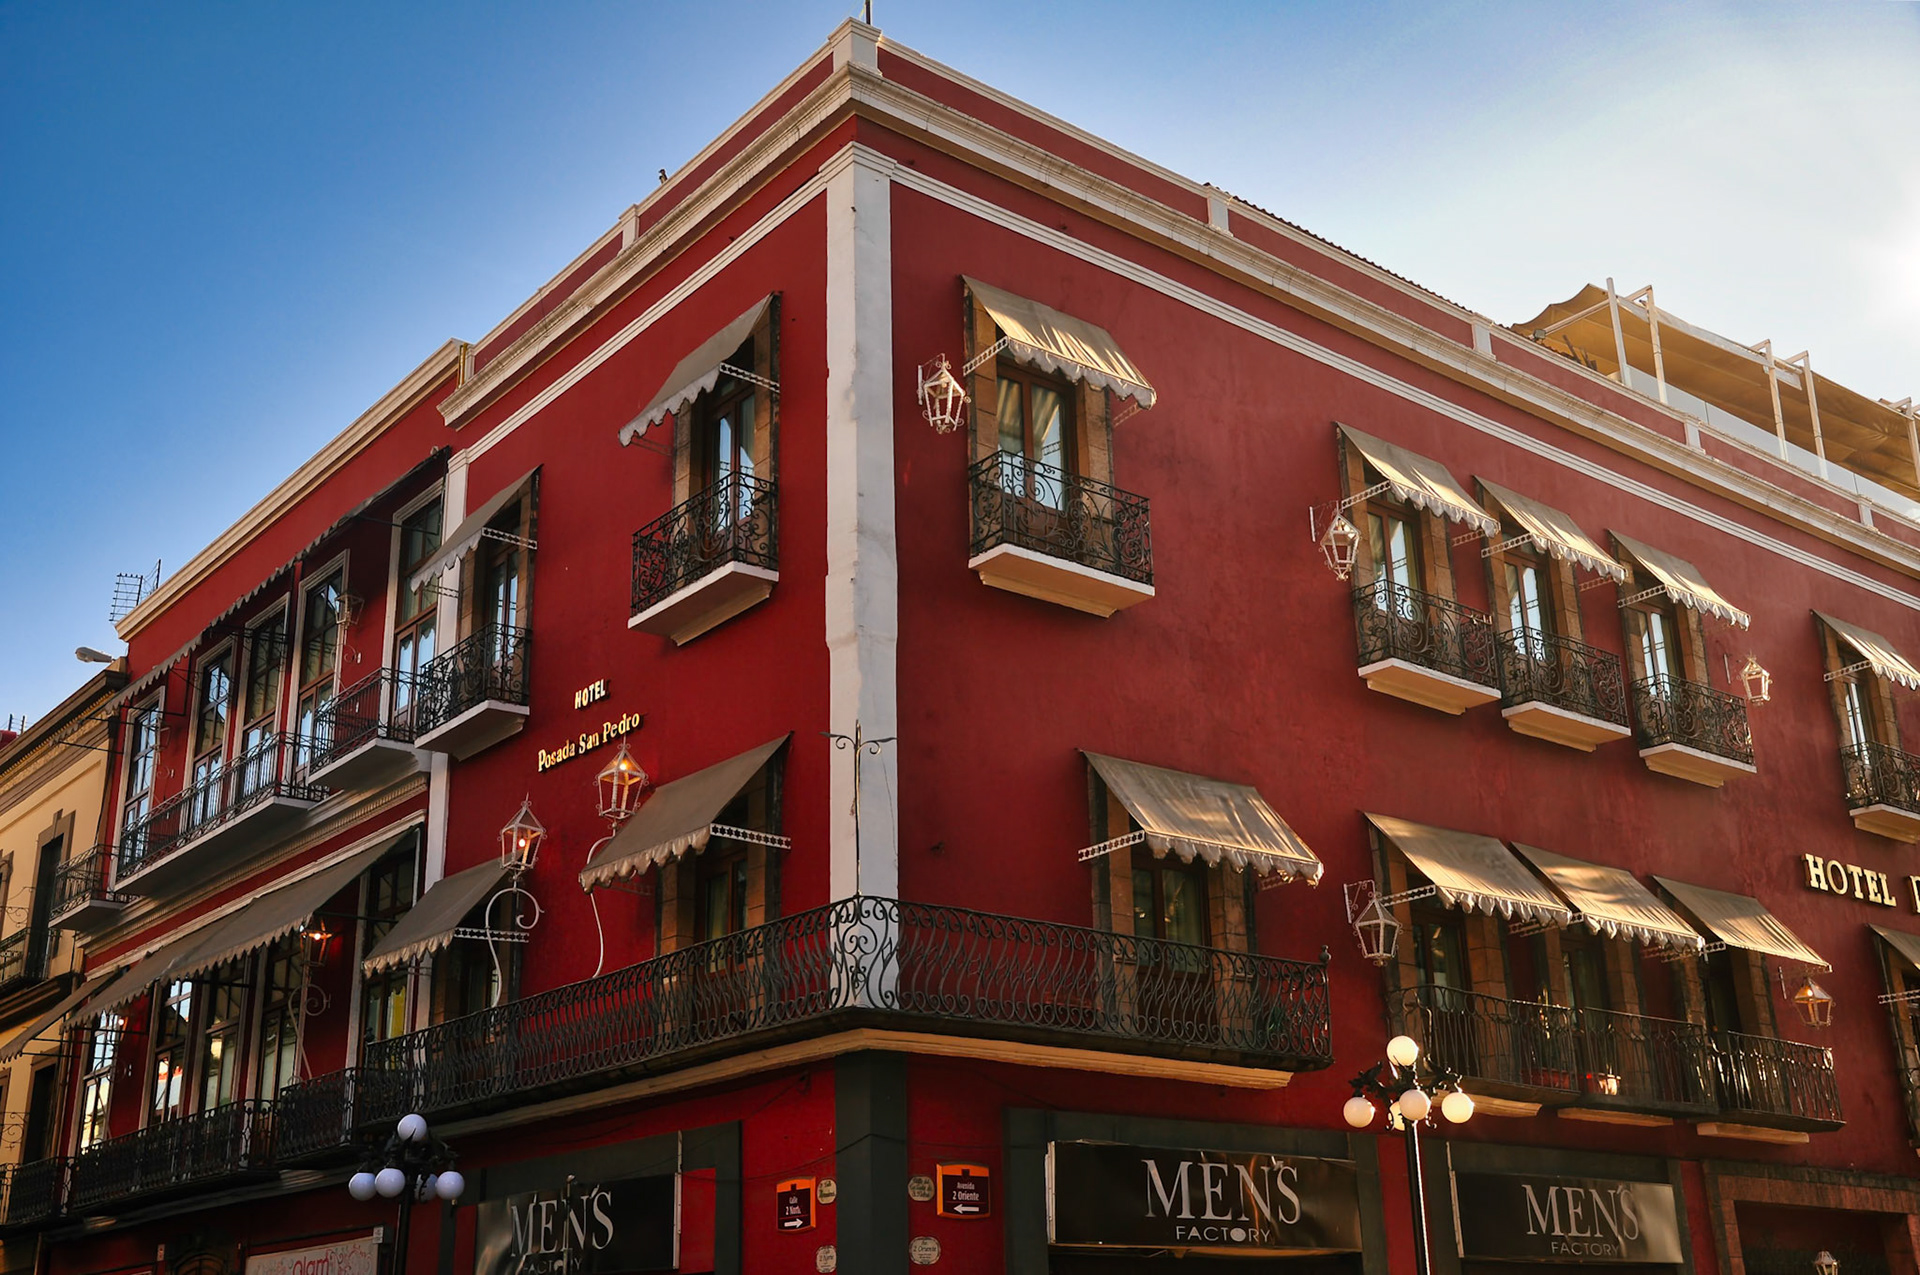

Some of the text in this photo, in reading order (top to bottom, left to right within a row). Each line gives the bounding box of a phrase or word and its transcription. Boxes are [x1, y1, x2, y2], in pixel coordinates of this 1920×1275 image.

[574, 678, 606, 710] HOTEL
[538, 712, 640, 773] Posada San Pedro
[1804, 852, 1897, 908] HOTEL
[952, 1190, 980, 1201] 2 Oriente
[1175, 1225, 1272, 1244] FACTORY
[1551, 1241, 1621, 1257] FACTORY
